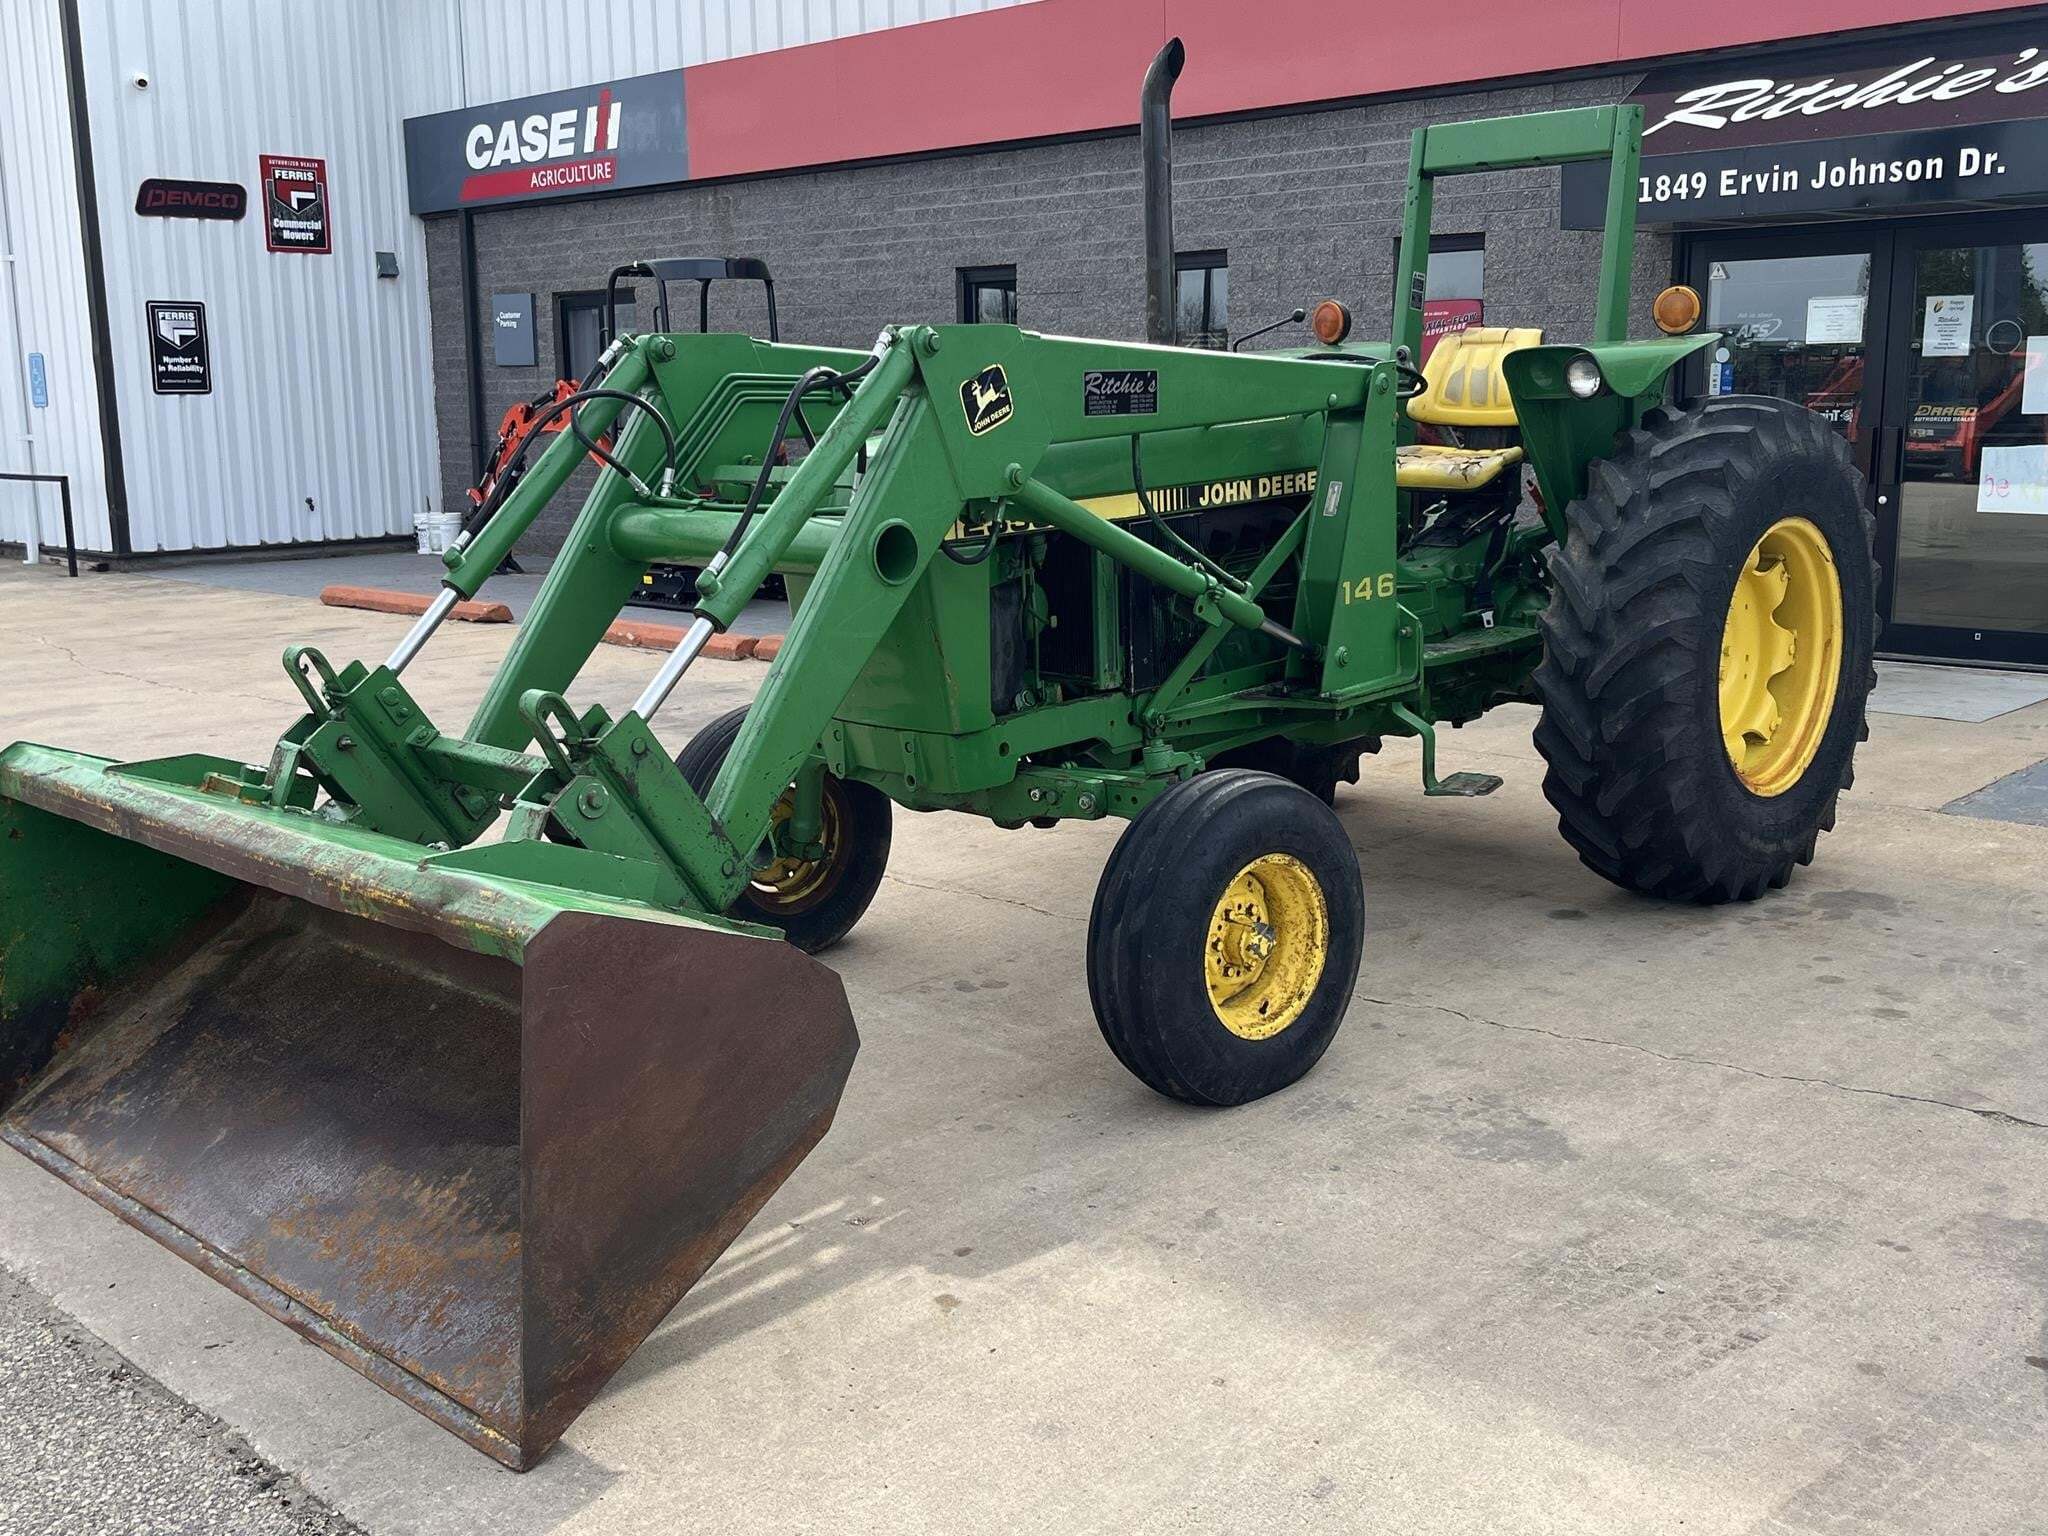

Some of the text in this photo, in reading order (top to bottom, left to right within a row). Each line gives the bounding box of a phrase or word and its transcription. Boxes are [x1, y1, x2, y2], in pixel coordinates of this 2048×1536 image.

[1641, 47, 2048, 136] Ritchie's
[465, 109, 578, 170] CASE
[274, 169, 315, 181] FERRIS
[530, 161, 612, 188] AGRICULTURE
[1639, 147, 2006, 203] 1849 Ervin Johnson Dr.
[145, 188, 239, 209] DEMCO
[273, 218, 322, 230] Commercial
[282, 229, 315, 241] Mowers
[157, 311, 195, 321] FERRIS
[1425, 312, 1478, 330] XIAL-FLOW
[1426, 322, 1468, 336] ADVANTAGE
[163, 355, 199, 364] Number 1
[168, 364, 204, 375] Reliability
[1085, 371, 1159, 396] Ritchie's
[973, 404, 1011, 432] JOHN DEERE
[1199, 470, 1318, 507] JOHN DEERE
[1342, 573, 1395, 605] 146
